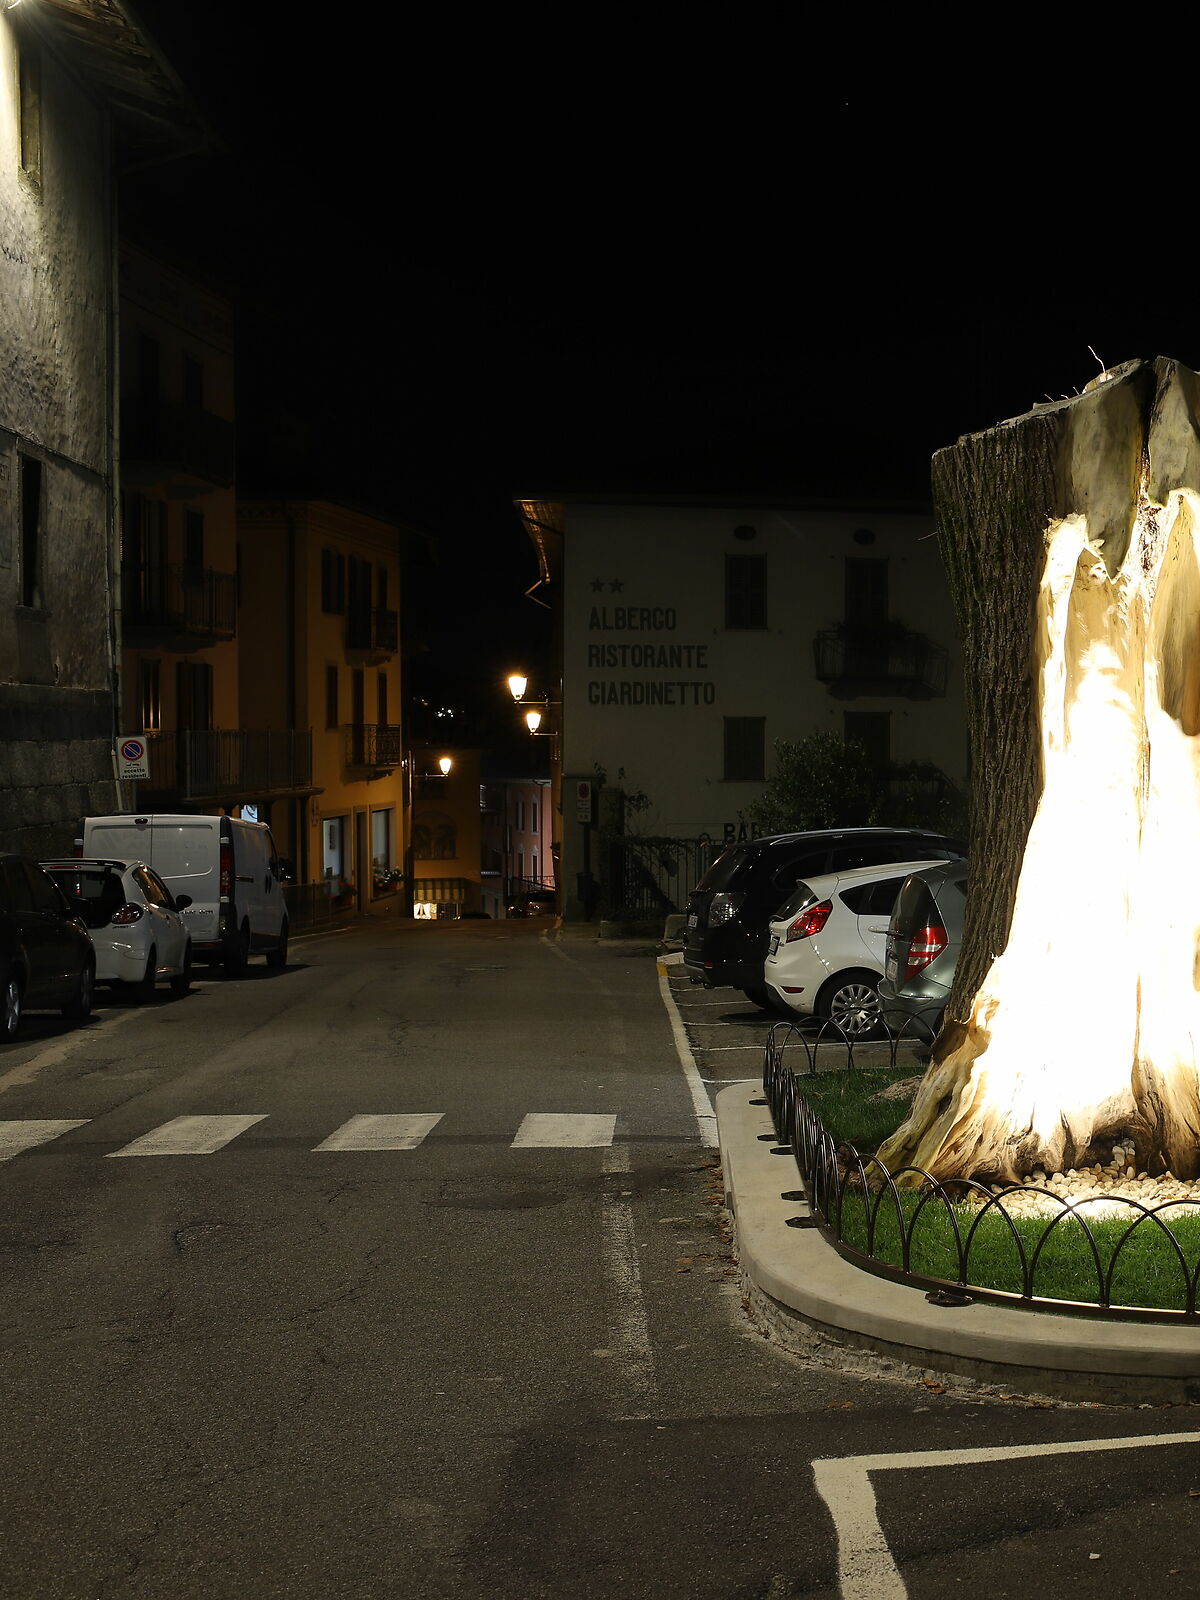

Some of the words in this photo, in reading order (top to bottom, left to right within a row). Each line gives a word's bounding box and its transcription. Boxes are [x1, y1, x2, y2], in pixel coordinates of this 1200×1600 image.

[588, 607, 677, 631] ALBERGO
[588, 644, 708, 669] RISTORANTE
[588, 681, 716, 706] GIARDINETTO
